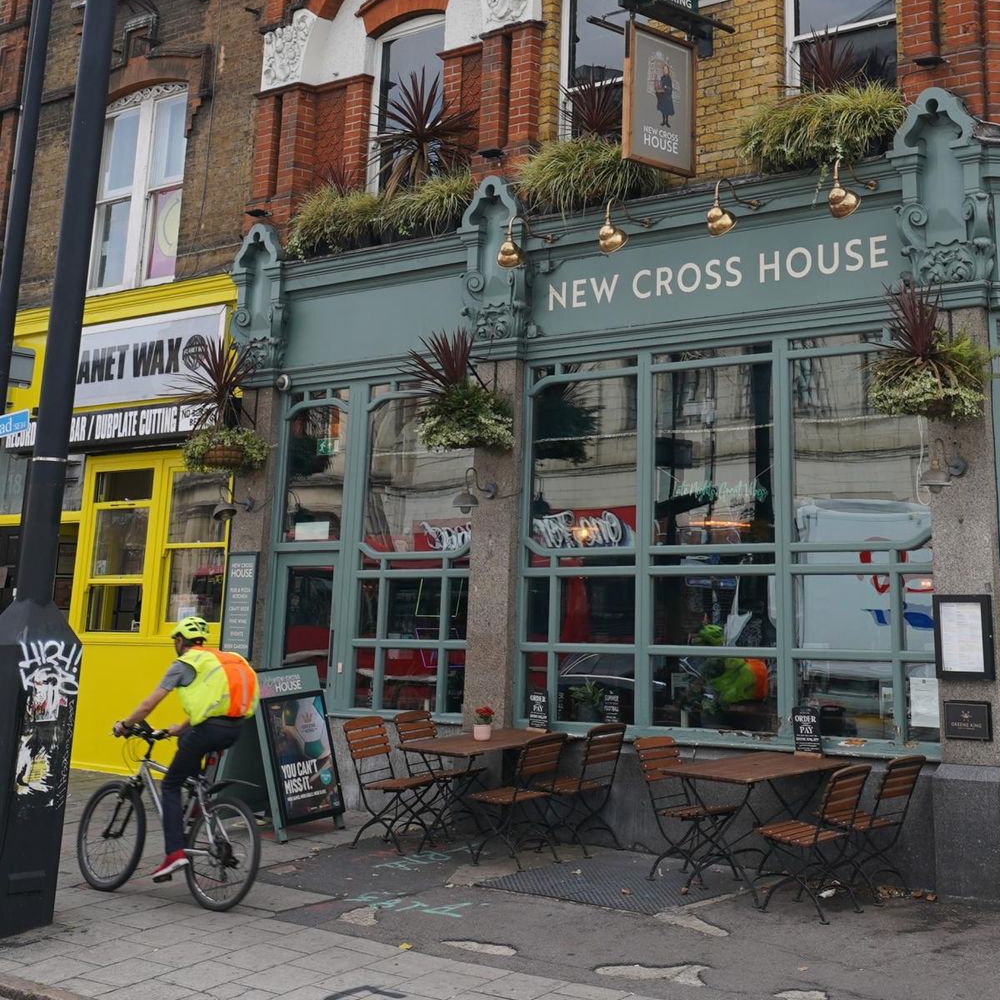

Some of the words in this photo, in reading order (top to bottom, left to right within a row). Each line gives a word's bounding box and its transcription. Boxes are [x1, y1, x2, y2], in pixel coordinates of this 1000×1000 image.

[643, 125, 658, 138] NEW
[658, 129, 679, 143] CROSS
[643, 133, 679, 155] HOUSE
[548, 273, 620, 312] NEW
[632, 256, 743, 300] CROSS
[759, 235, 889, 283] HOUSE
[76, 344, 130, 385] ANET
[132, 337, 183, 378] WAX
[69, 416, 87, 442] BAR
[94, 410, 138, 440] DUBPLATE
[139, 407, 178, 435] CUTTING
[230, 568, 253, 578] HOUSE
[275, 679, 303, 693] HOUSE
[794, 715, 817, 723] ORDER
[800, 726, 814, 734] PAY
[281, 762, 297, 779] YOU
[296, 759, 318, 776] CAN'T
[284, 777, 304, 795] MISS
[302, 775, 313, 791] IT.
